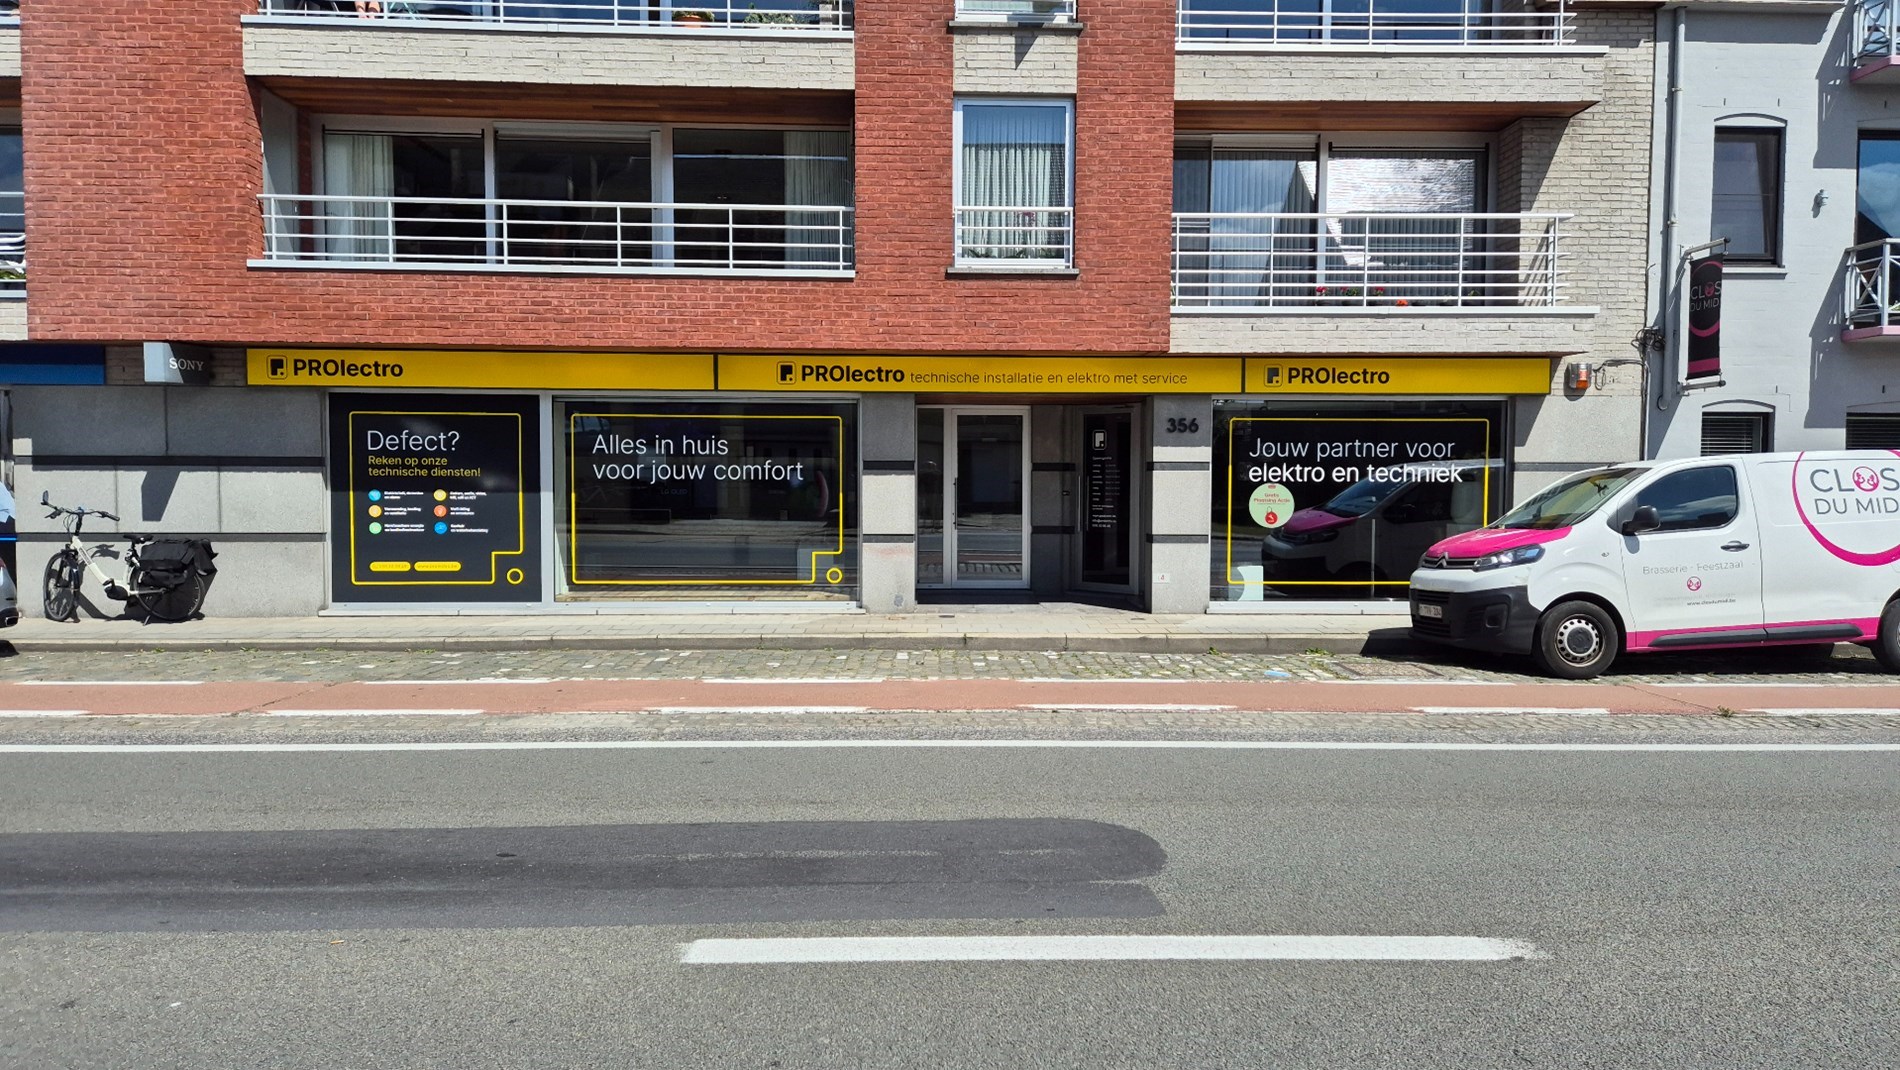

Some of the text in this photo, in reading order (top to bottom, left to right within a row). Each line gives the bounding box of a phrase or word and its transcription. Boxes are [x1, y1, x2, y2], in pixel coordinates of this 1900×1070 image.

[169, 357, 204, 371] SONY
[294, 359, 403, 377] PROlectro
[801, 365, 1188, 385] PROlectro technische installatie en elektro met service
[1288, 367, 1390, 384] PROlectro
[1167, 418, 1200, 434] 356
[366, 430, 460, 451] Defect?
[592, 434, 729, 455] Alles in huis
[1249, 437, 1456, 462] Jouw partner voor
[368, 455, 448, 468] Reken op onze
[368, 466, 481, 477] technische diensten!
[592, 459, 804, 485] voor jouw comfort
[1248, 463, 1464, 483] elektro en techniek
[1809, 466, 1900, 493] CLOS
[1814, 497, 1899, 515] DU MID
[1642, 563, 1688, 575] Brasserie
[1696, 560, 1744, 572] Feestzaal
